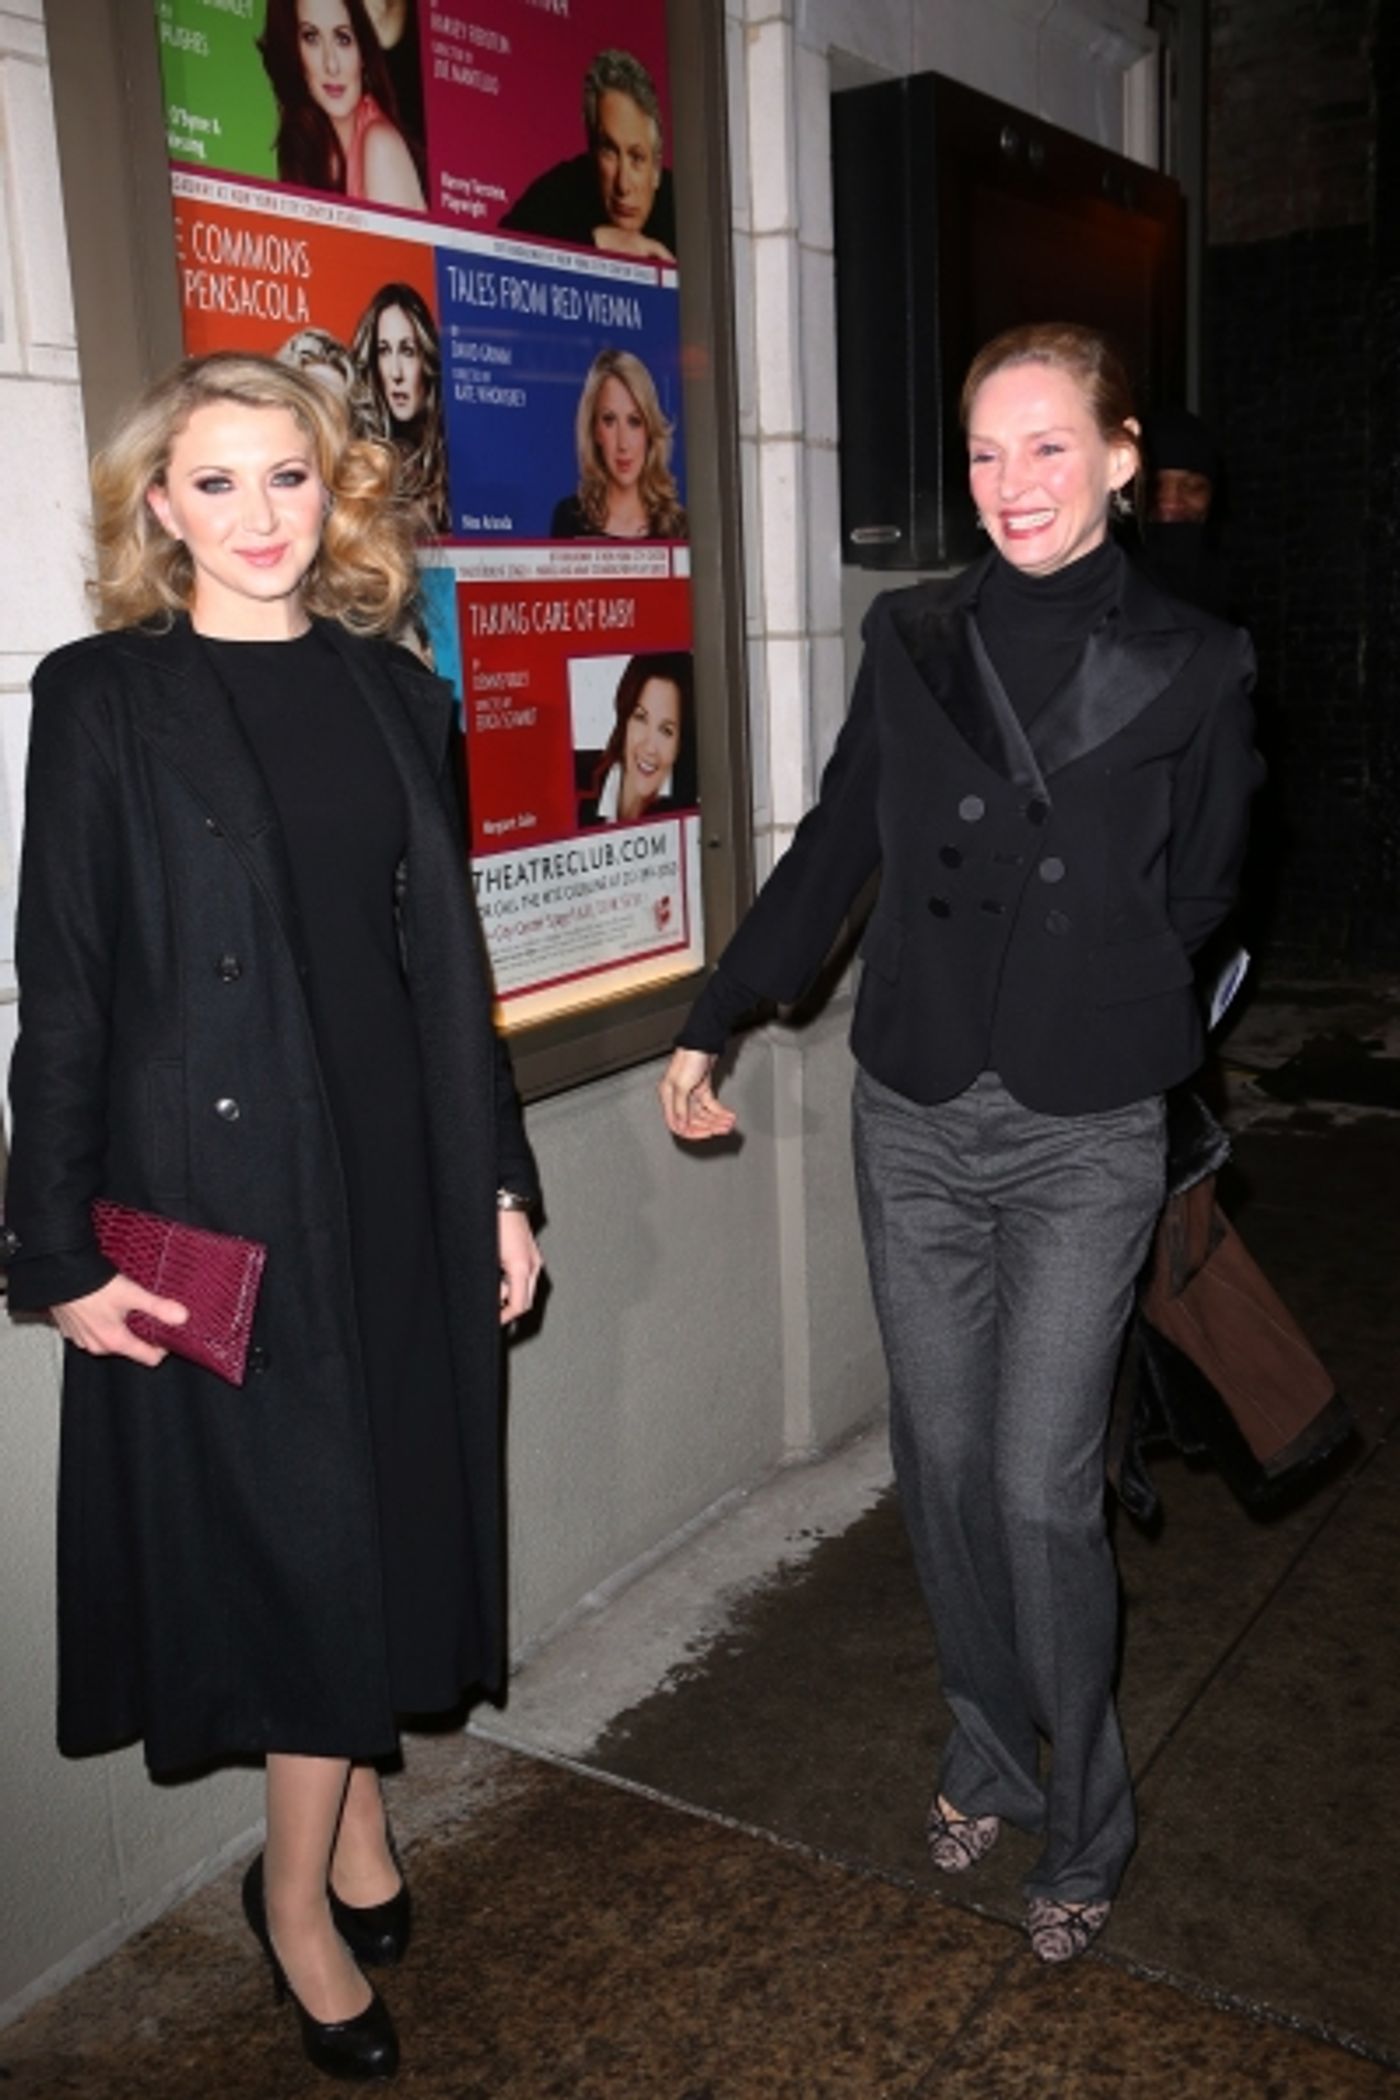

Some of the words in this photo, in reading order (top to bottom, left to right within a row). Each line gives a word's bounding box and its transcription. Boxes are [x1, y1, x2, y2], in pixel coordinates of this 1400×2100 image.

[192, 223, 311, 279] COMMONS
[184, 269, 310, 323] PENSACOLA
[447, 266, 497, 308] TALES
[501, 276, 547, 316] FROM
[552, 283, 582, 320] RED
[585, 291, 642, 330] VIENNA
[469, 602, 529, 637] TAKING
[532, 600, 571, 633] CARE
[574, 599, 595, 631] OF
[599, 598, 636, 629] BABY
[472, 834, 667, 895] THEATRECLUB.COM
